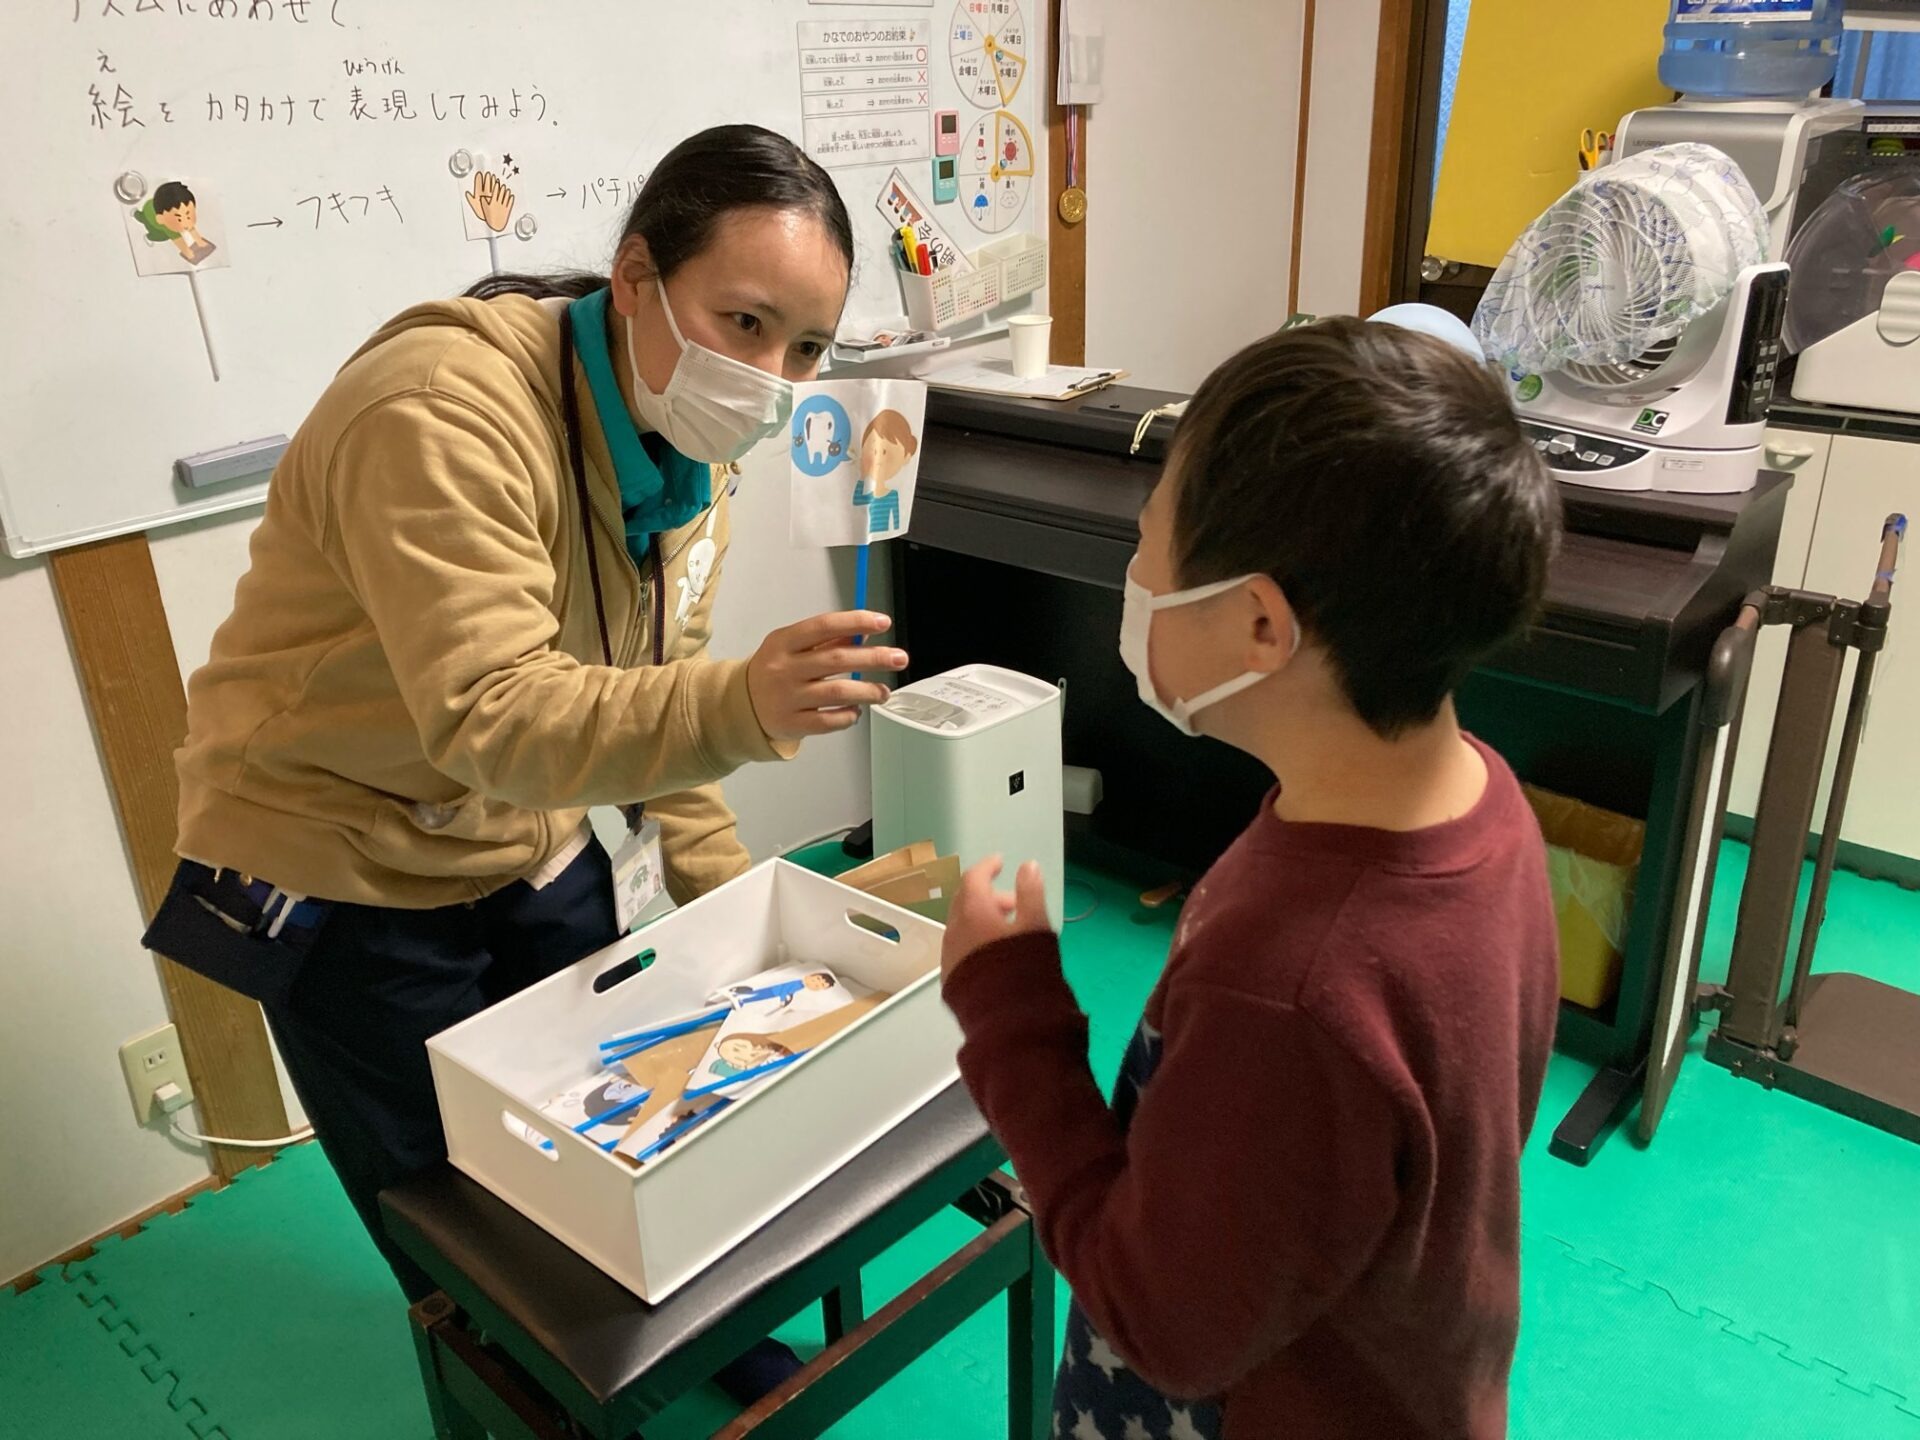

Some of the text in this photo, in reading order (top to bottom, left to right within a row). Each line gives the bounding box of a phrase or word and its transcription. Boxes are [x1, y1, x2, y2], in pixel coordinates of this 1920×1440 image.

[969, 2, 988, 13] 日曜日
[991, 3, 1009, 14] 月曜日
[953, 30, 973, 41] 土曜日
[1003, 34, 1022, 45] 火曜日
[97, 49, 116, 73] え
[342, 57, 405, 76] ひょうげん
[958, 65, 978, 76] 金曜日
[999, 67, 1017, 78] 水曜日
[977, 86, 997, 96] 木曜日
[1638, 410, 1667, 427] DC
